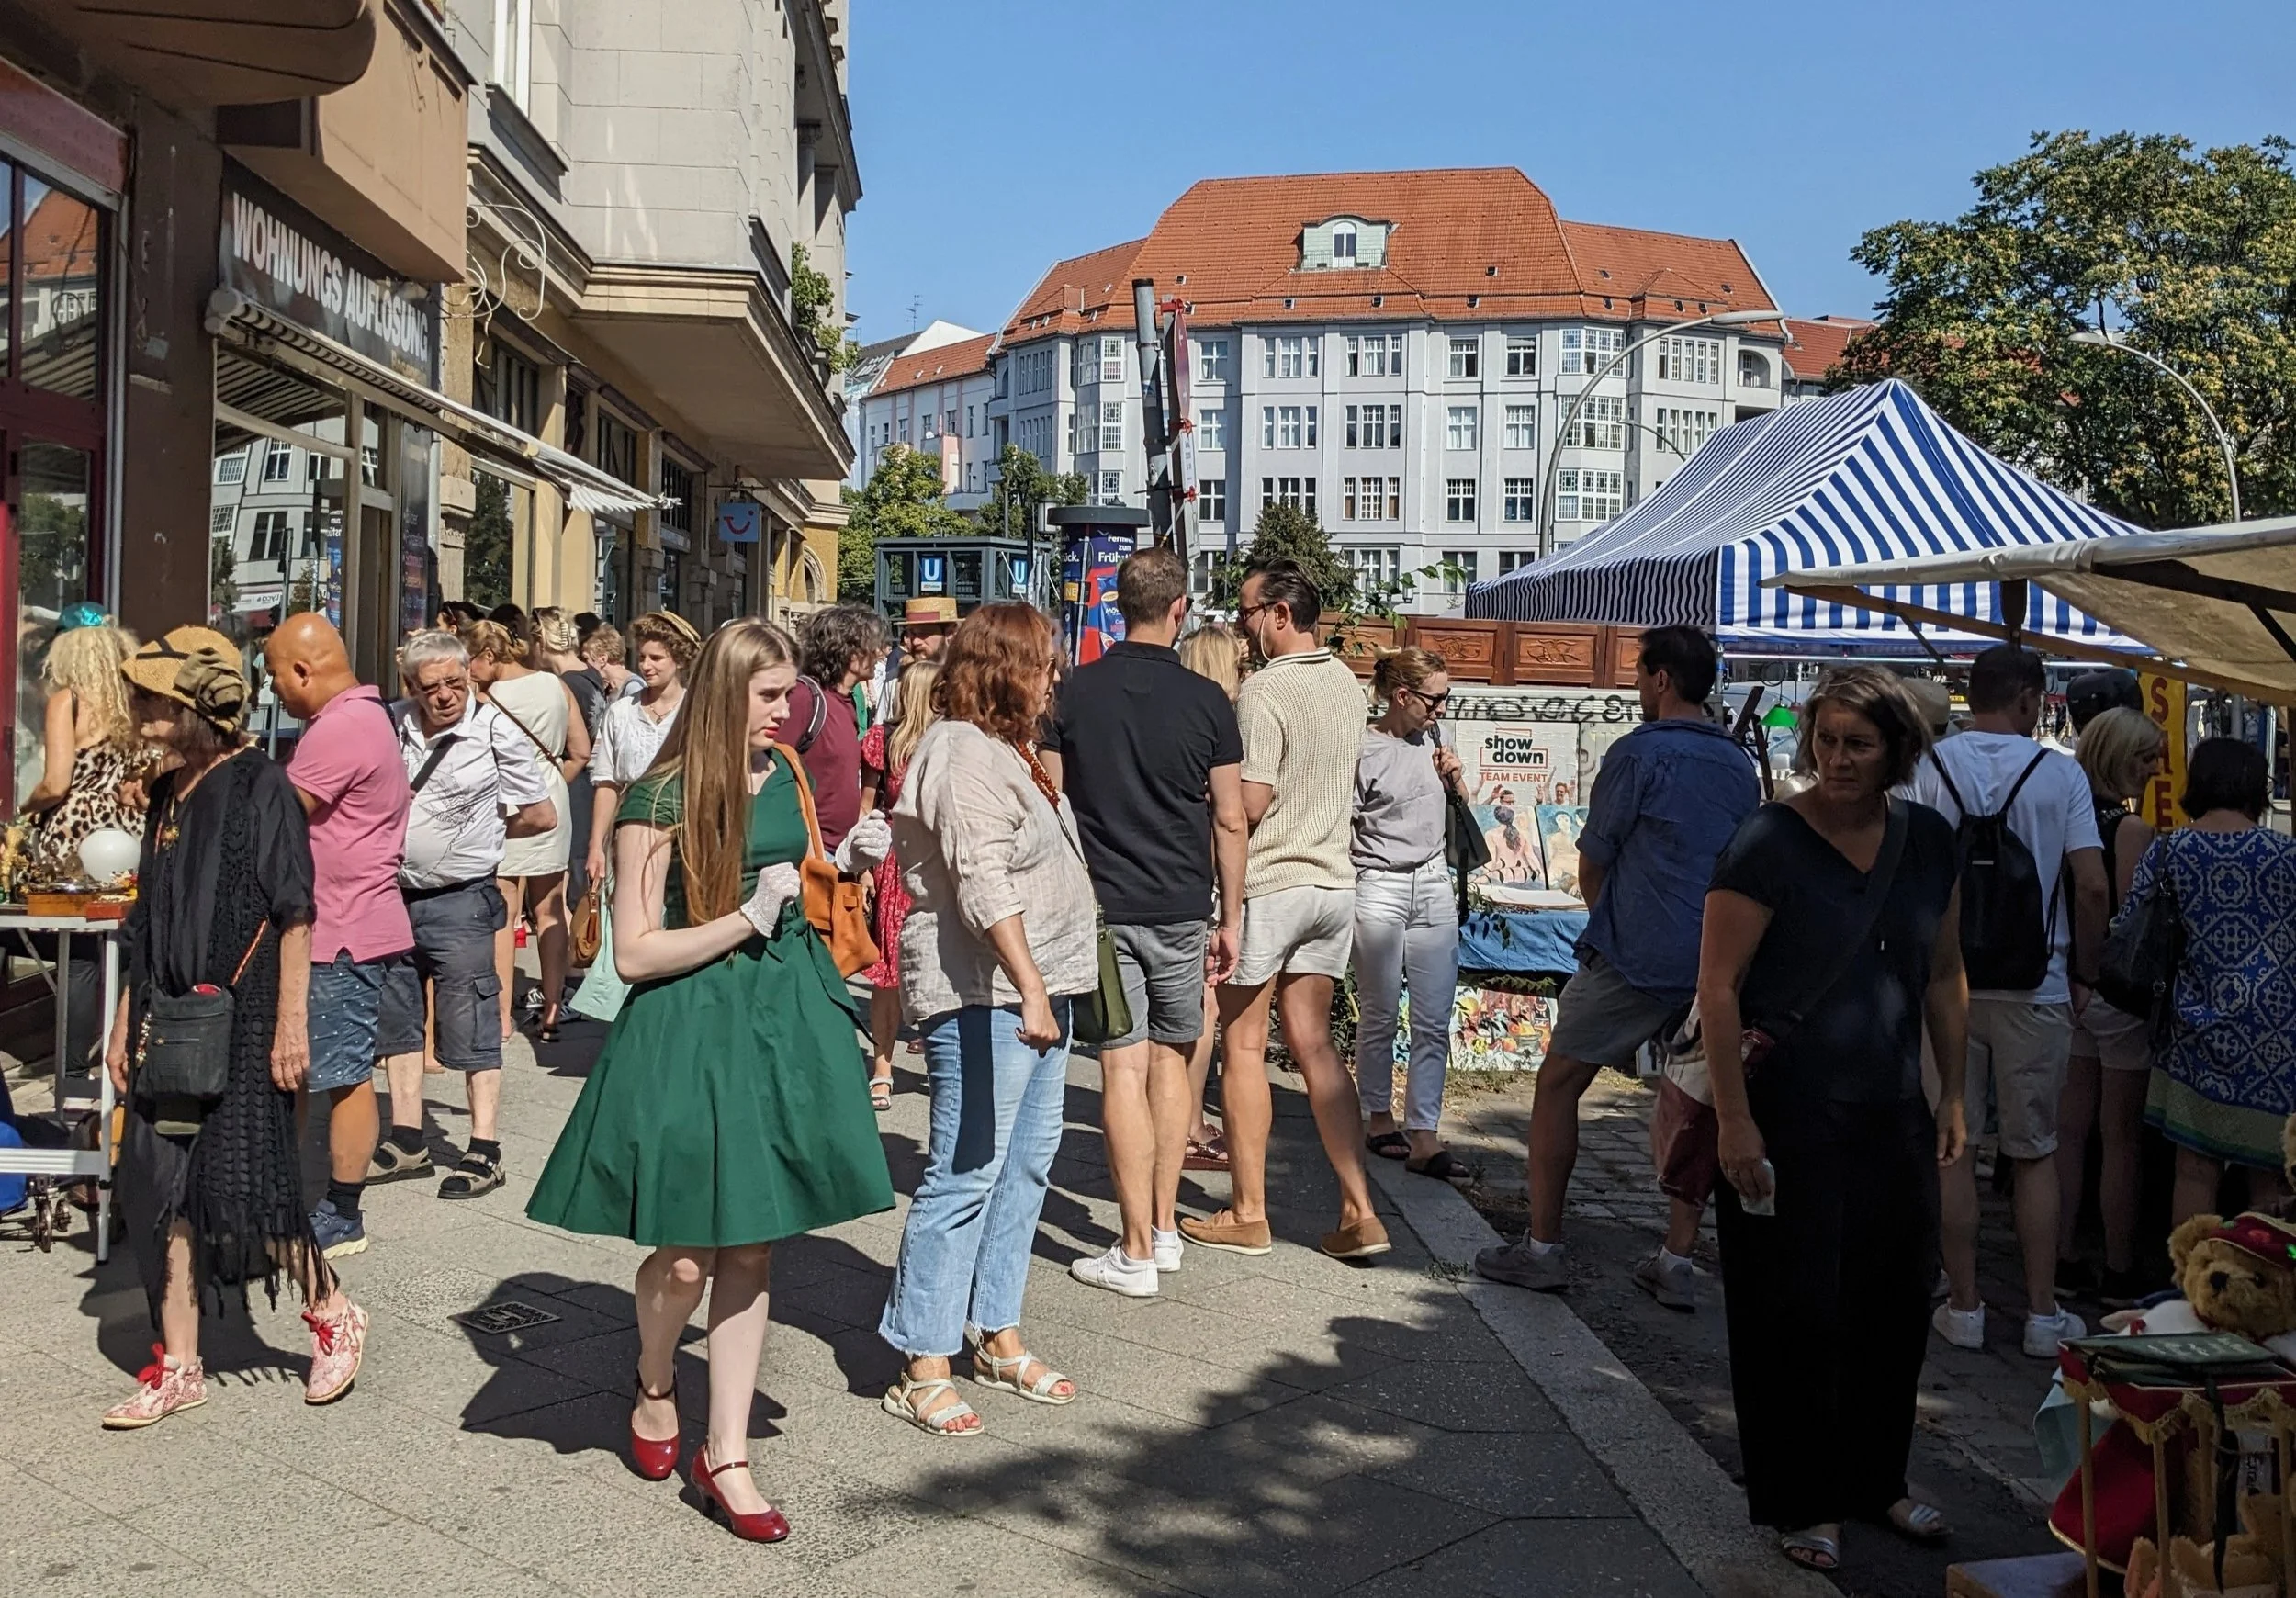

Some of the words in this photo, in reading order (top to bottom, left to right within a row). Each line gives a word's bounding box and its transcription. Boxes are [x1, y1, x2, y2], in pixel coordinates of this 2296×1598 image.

[233, 192, 343, 314] WOHNUNGS
[344, 267, 428, 361] AUFLÖSUNG
[924, 558, 940, 581] U
[1015, 560, 1025, 583] U
[1484, 735, 1533, 750] show
[1492, 748, 1544, 764] down
[1480, 772, 1509, 782] TEAM
[1513, 773, 1548, 782] EVENT
